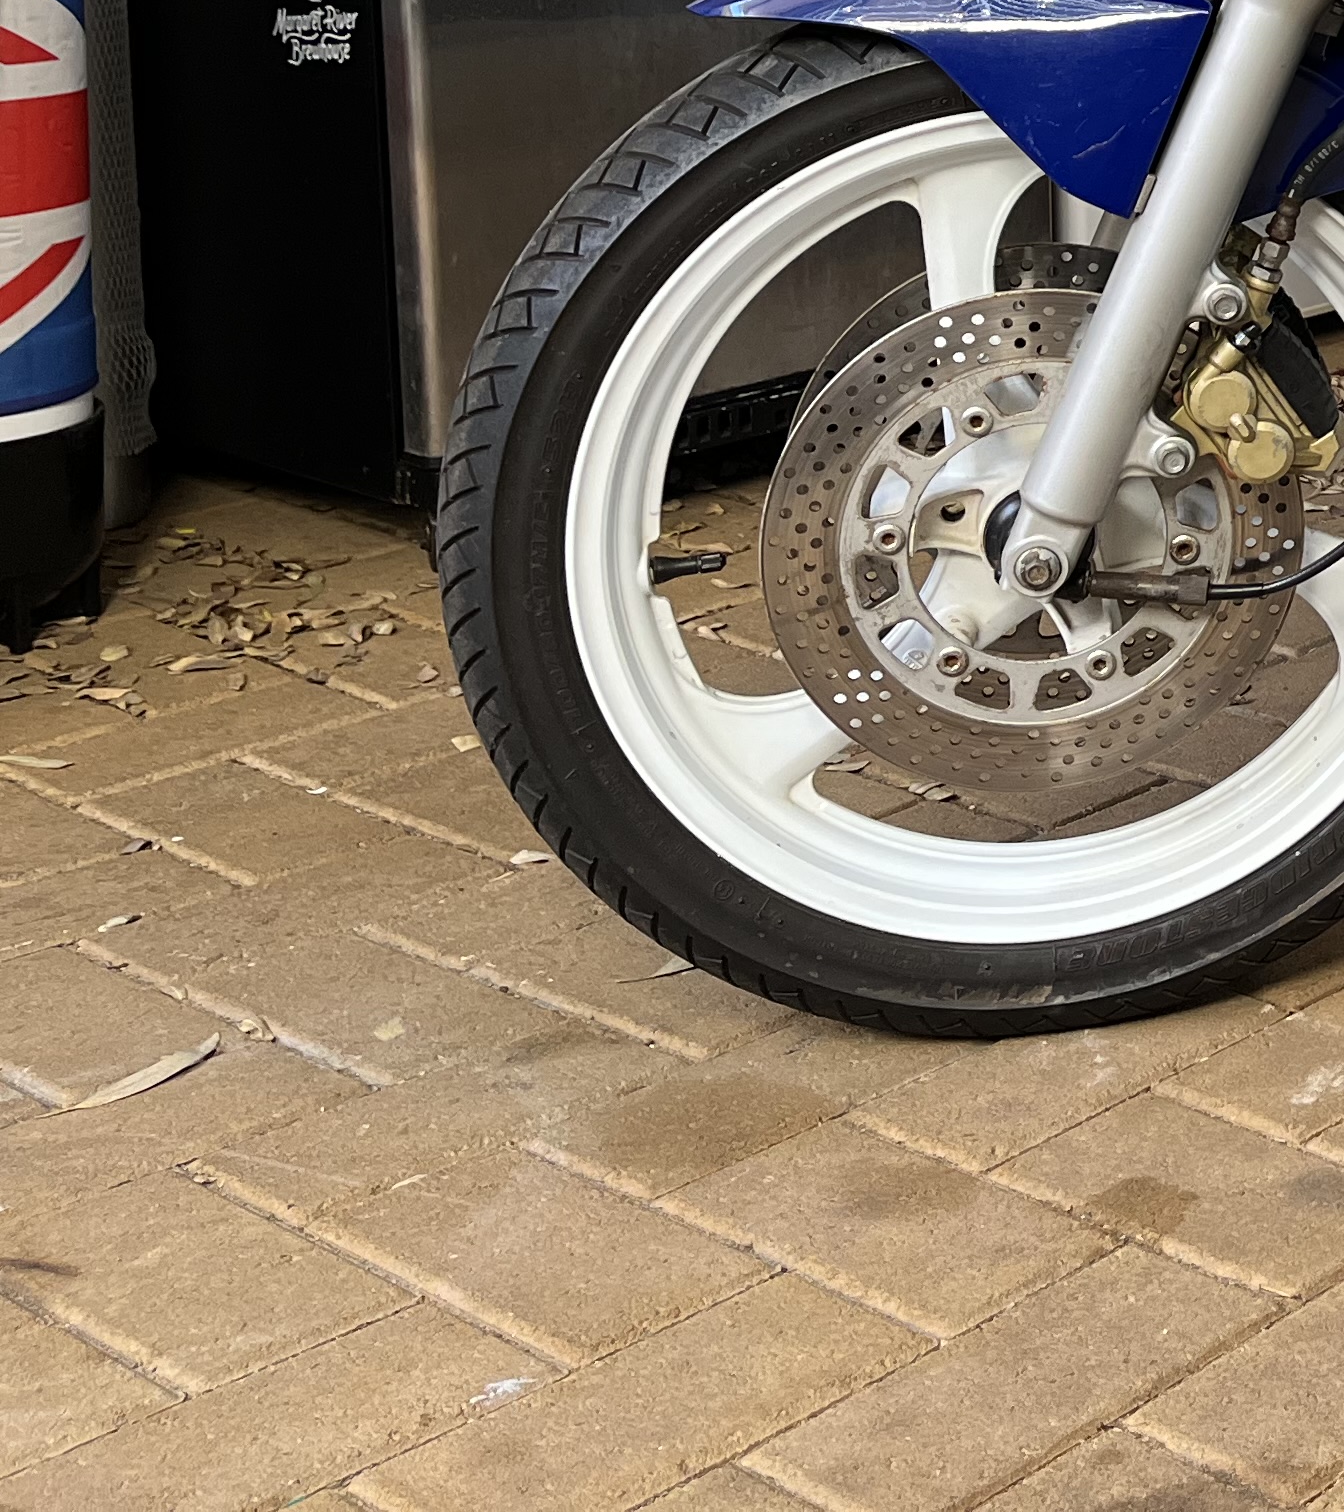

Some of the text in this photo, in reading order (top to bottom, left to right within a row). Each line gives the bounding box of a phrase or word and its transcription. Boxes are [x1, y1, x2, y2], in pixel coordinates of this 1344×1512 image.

[272, 5, 359, 41] Margaret River
[287, 38, 351, 67] Brewhouse
